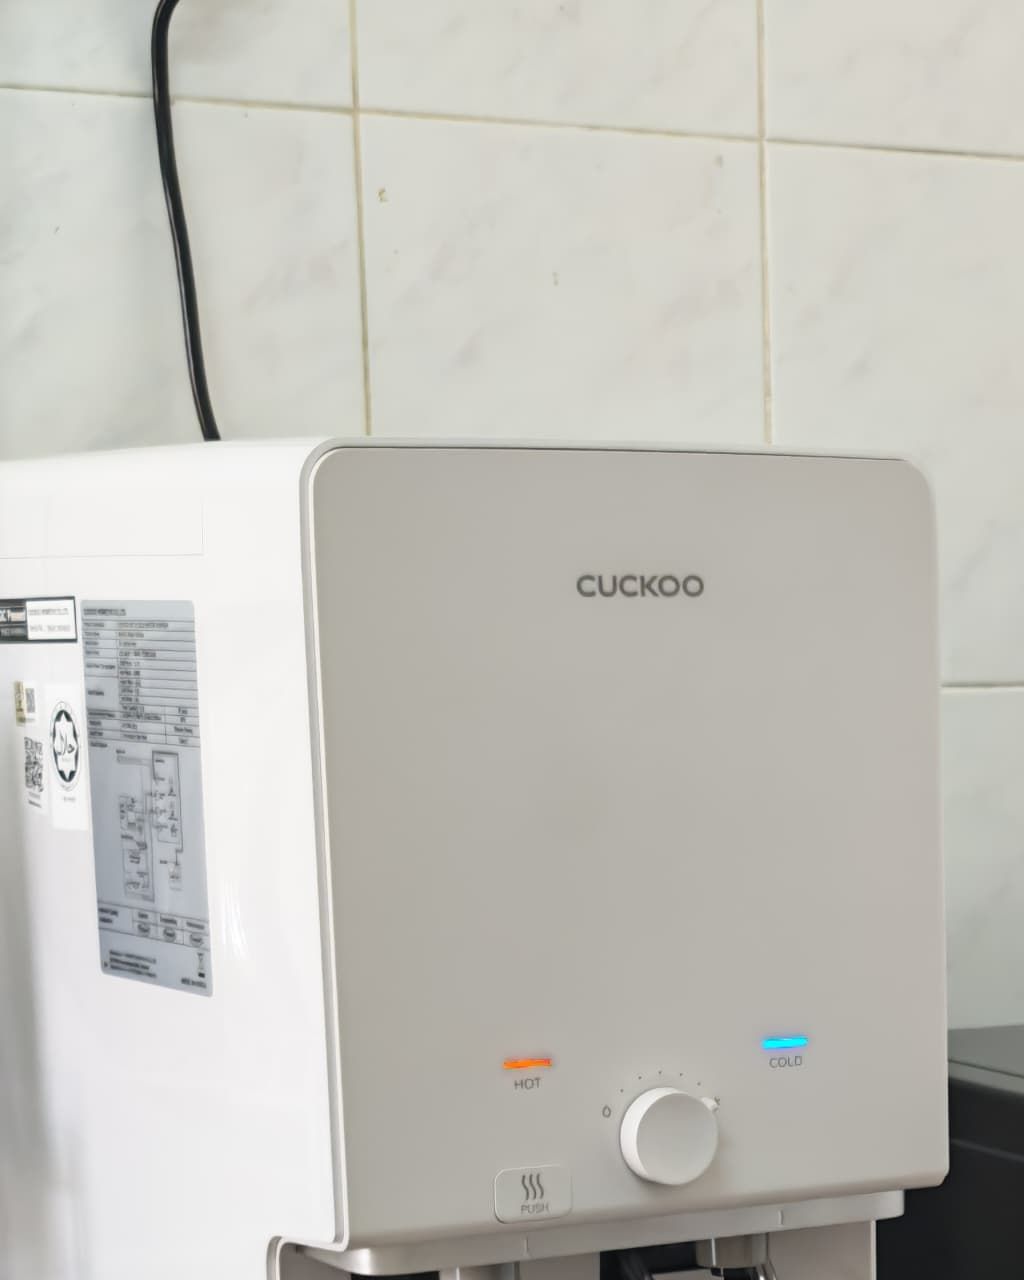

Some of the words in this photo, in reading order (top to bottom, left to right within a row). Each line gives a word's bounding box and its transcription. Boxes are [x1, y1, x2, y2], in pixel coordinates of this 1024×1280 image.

[576, 574, 705, 598] CUCKOO
[769, 1055, 803, 1069] COLD
[514, 1077, 542, 1090] HOT
[520, 1202, 550, 1215] PUSH
